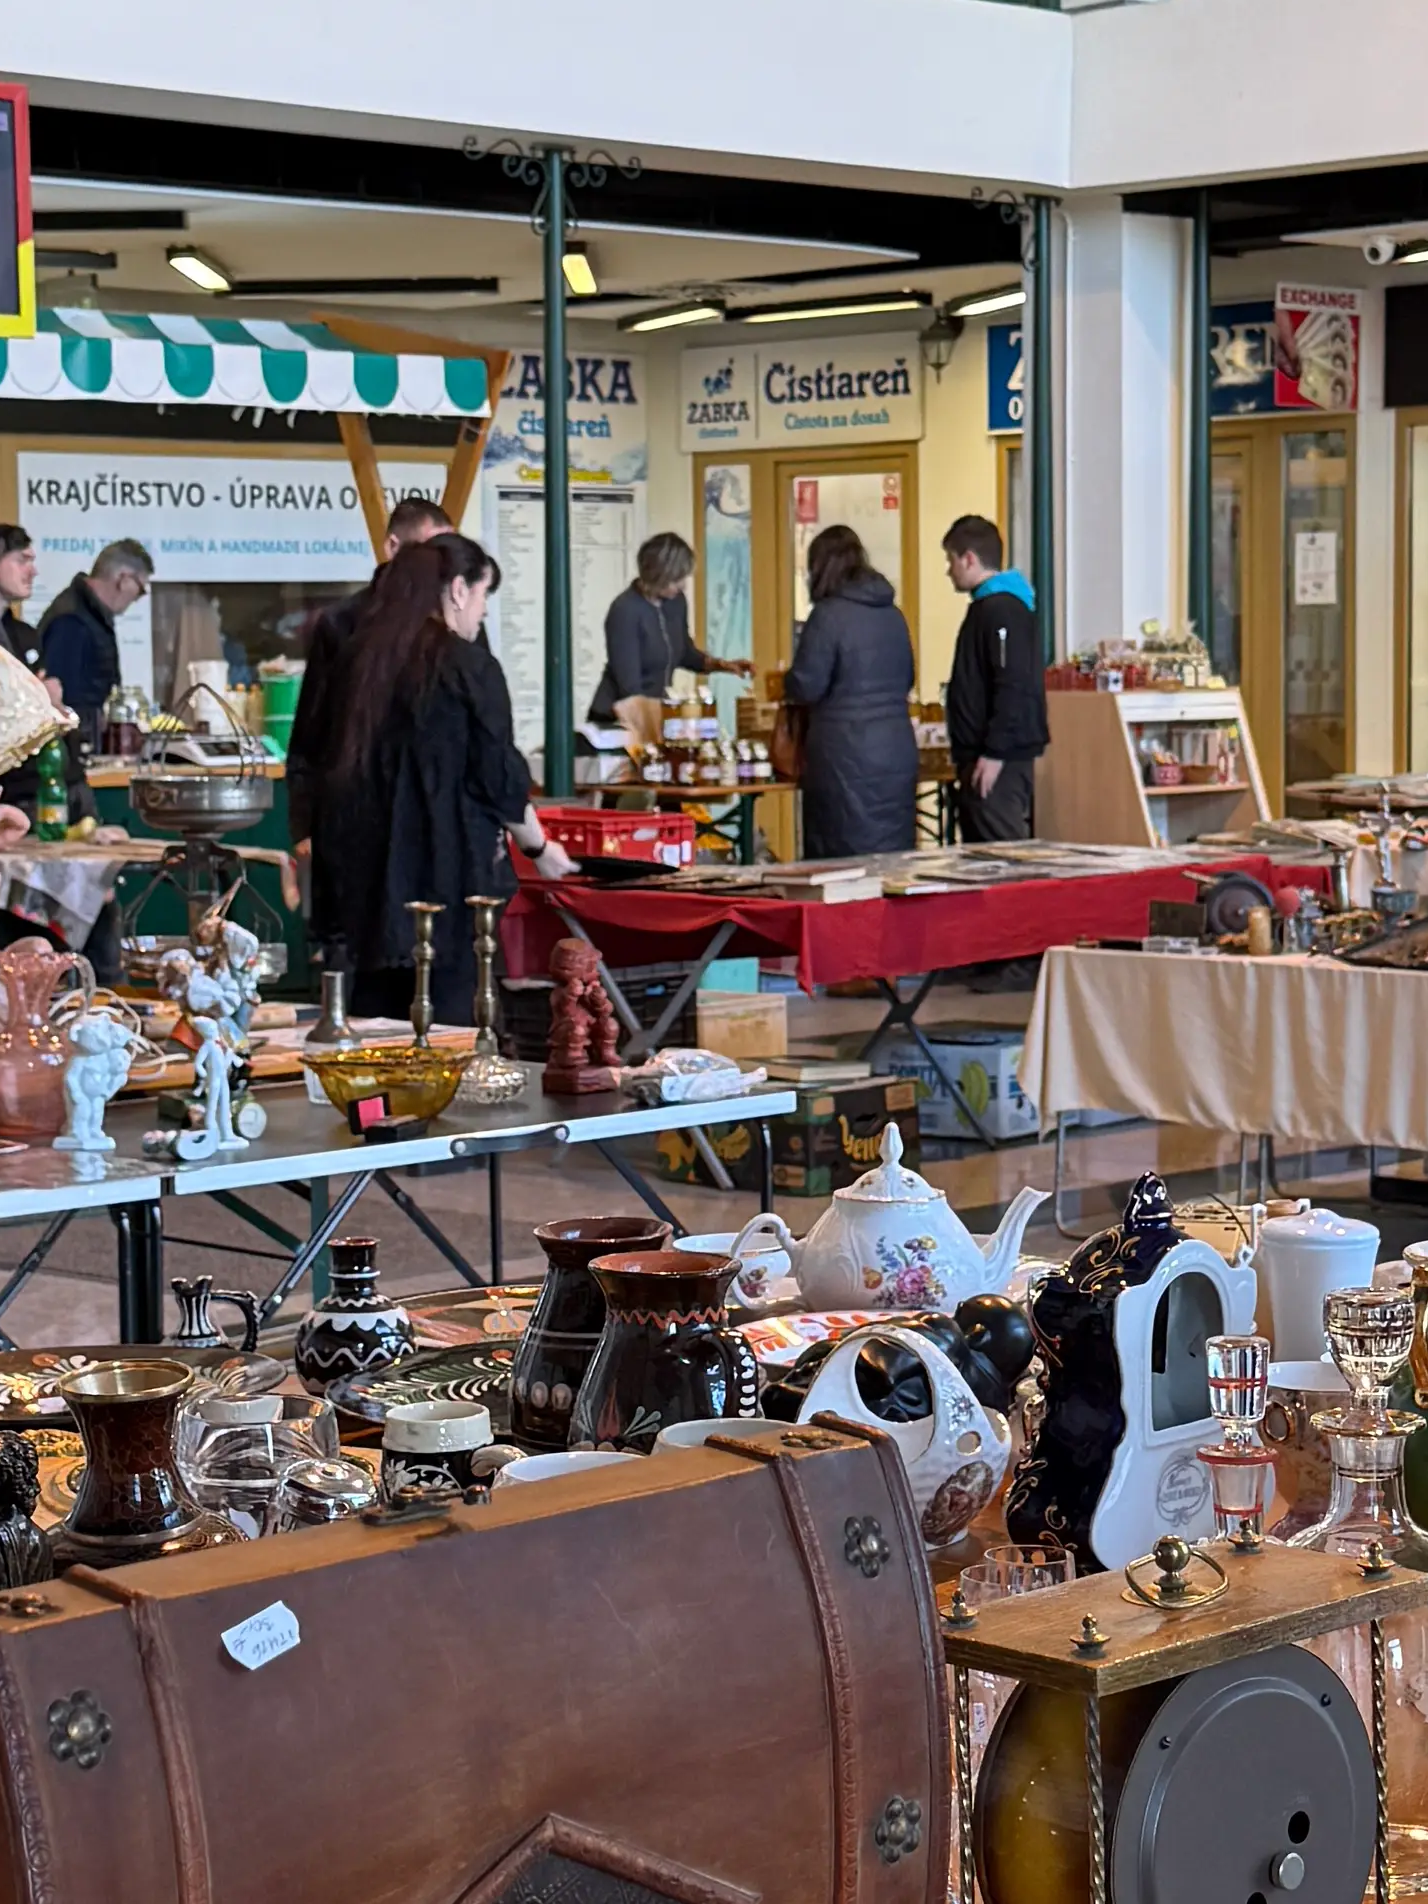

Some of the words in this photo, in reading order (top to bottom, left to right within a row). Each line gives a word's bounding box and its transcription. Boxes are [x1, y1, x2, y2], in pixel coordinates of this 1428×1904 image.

[1280, 287, 1357, 310] EXCHANGE
[764, 358, 912, 405] Čistiareň
[518, 410, 612, 438] čisareň
[26, 472, 206, 513] KRAJČÍRSTVO
[229, 476, 333, 510] ÚPRAVA
[41, 538, 94, 556] PREDAJ
[159, 536, 201, 553] MIKÍN
[208, 539, 218, 553] A
[220, 539, 300, 555] HANDMADE
